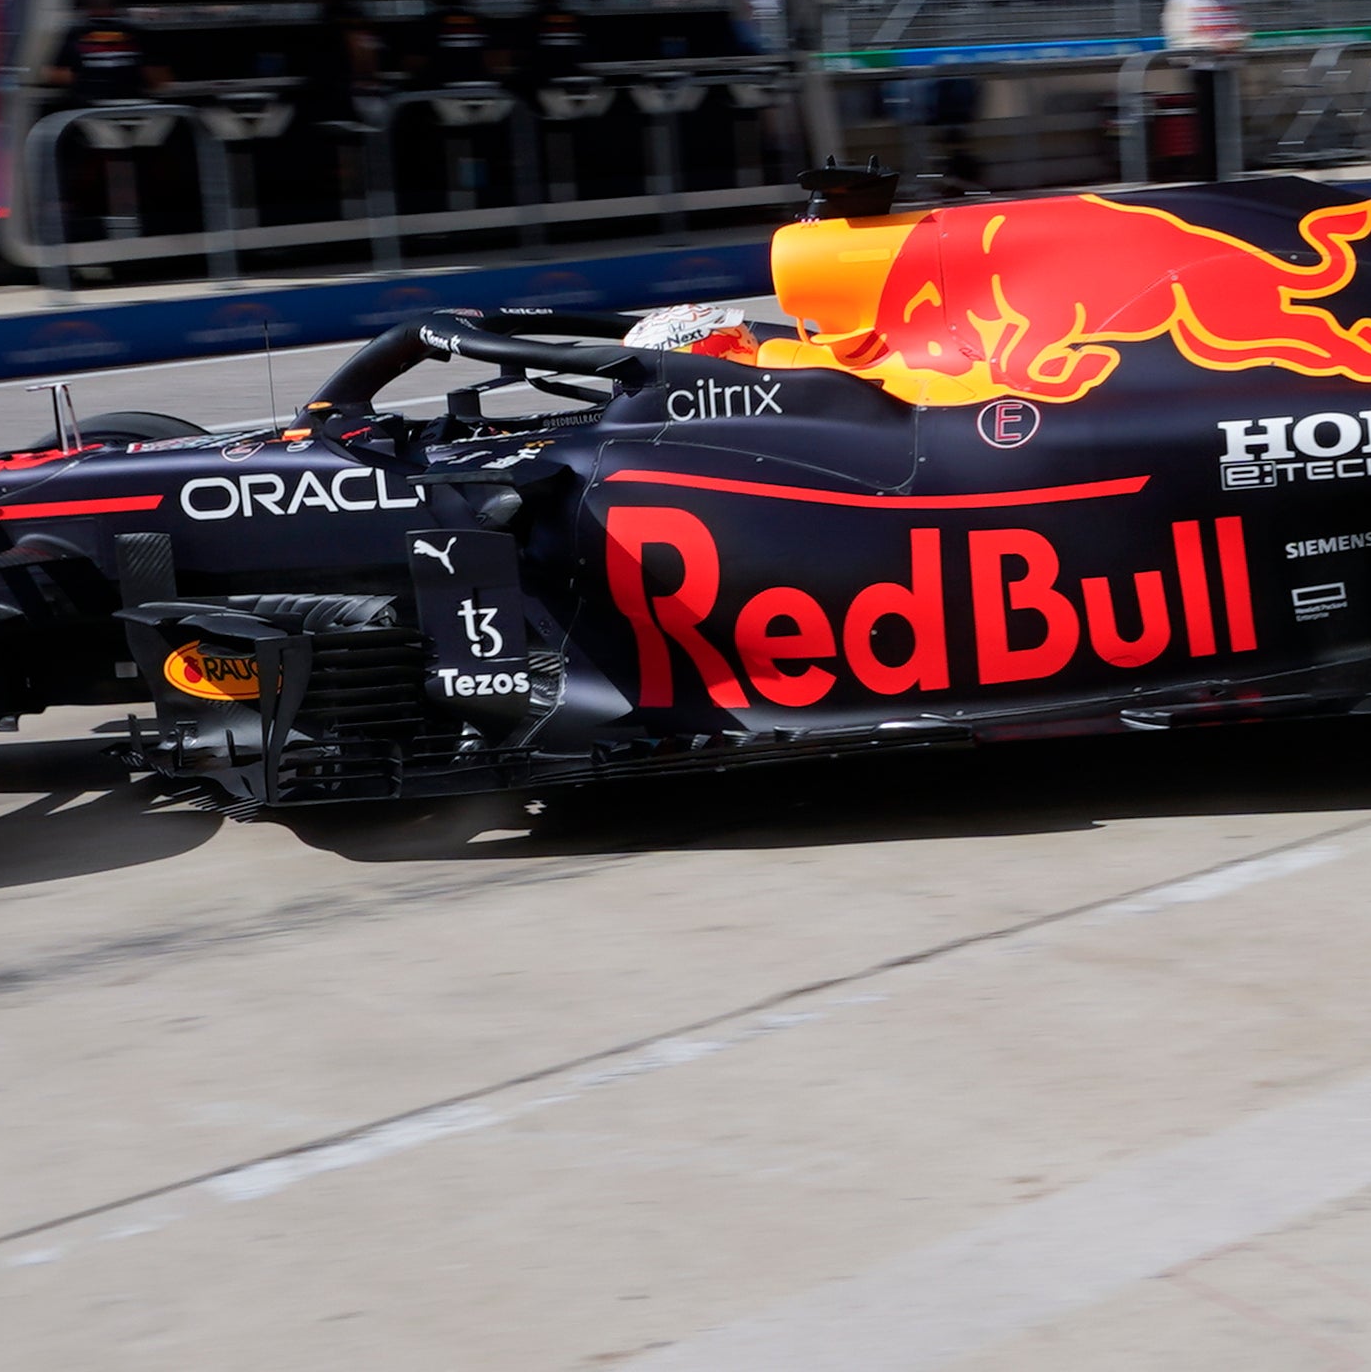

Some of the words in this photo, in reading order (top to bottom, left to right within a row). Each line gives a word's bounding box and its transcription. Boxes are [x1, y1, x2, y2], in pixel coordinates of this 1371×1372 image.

[666, 374, 783, 424] citrix
[179, 467, 426, 521] ORACL
[438, 668, 530, 697] Tezos
